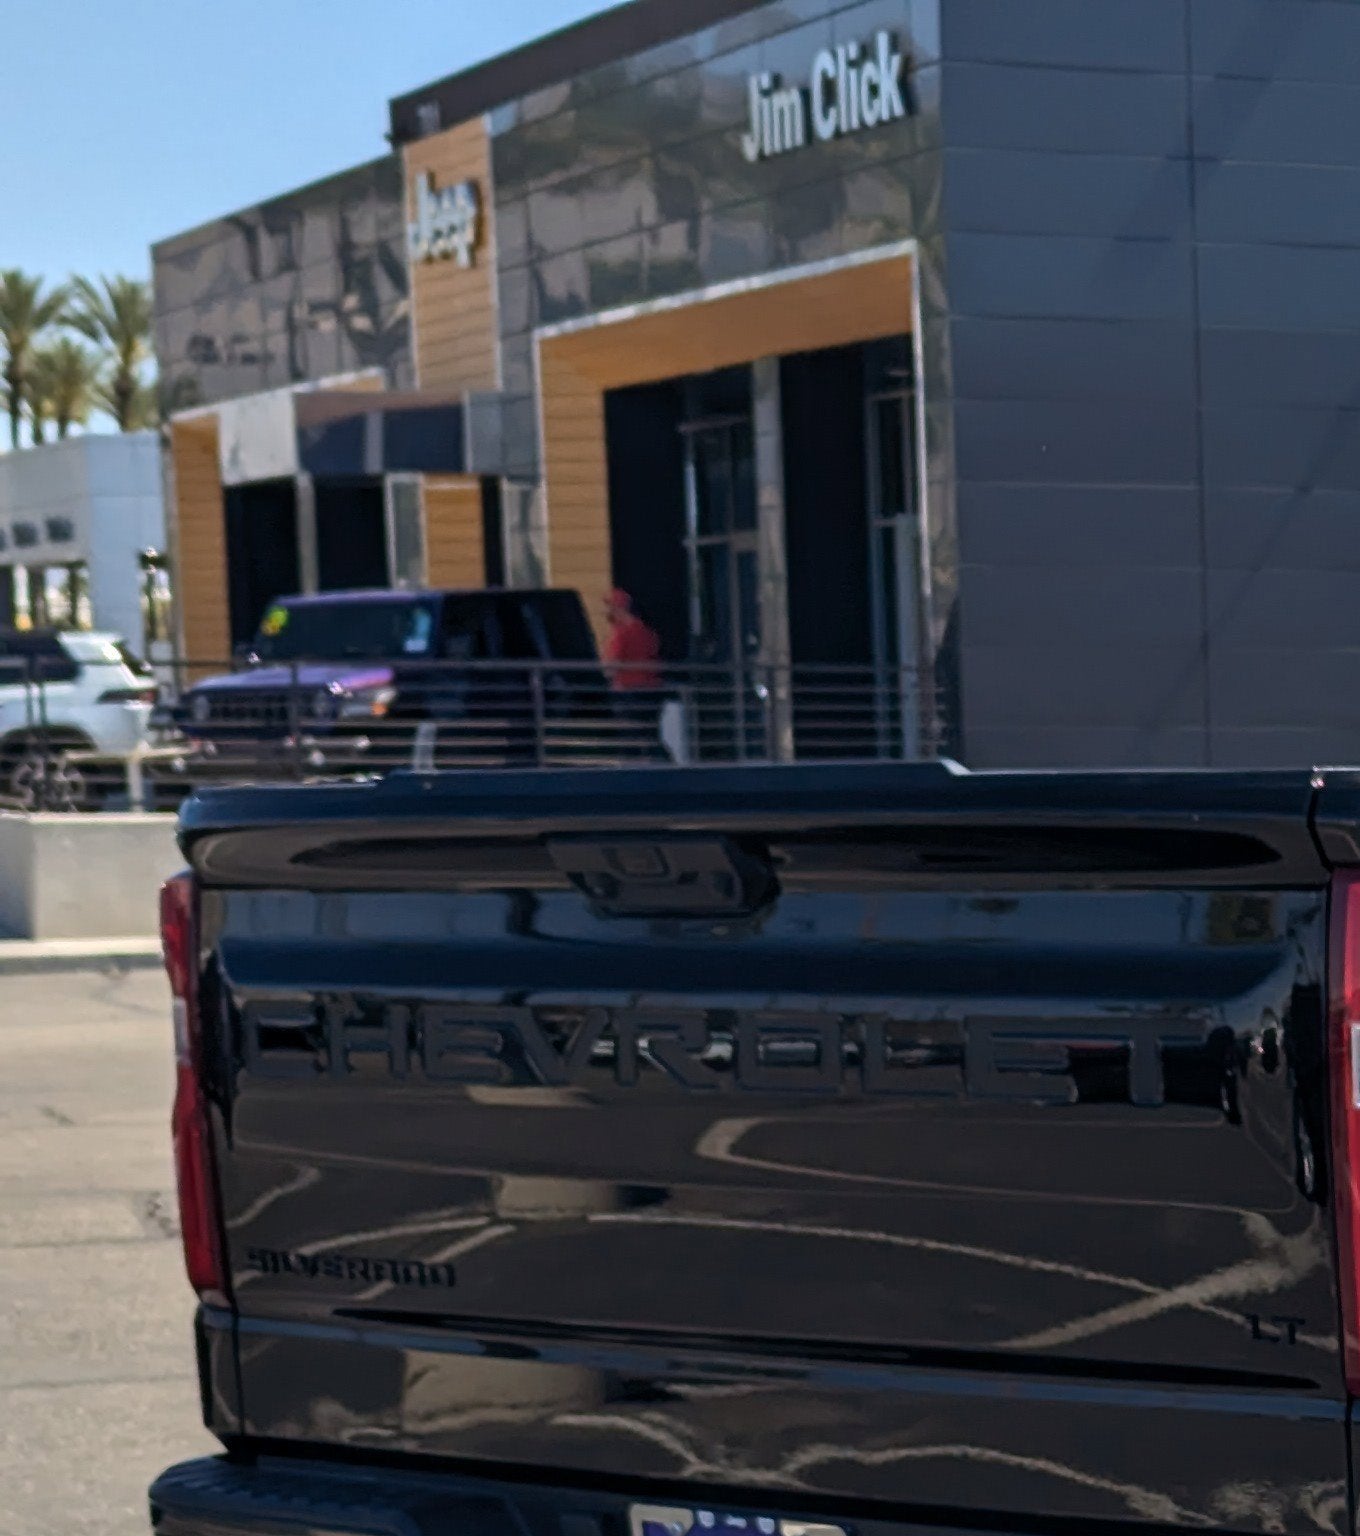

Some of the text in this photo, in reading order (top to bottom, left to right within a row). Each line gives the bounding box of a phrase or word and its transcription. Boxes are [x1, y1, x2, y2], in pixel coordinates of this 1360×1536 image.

[741, 31, 904, 163] Jim Click
[244, 1002, 1208, 1107] CHEVROLET
[1244, 1313, 1306, 1345] LT
